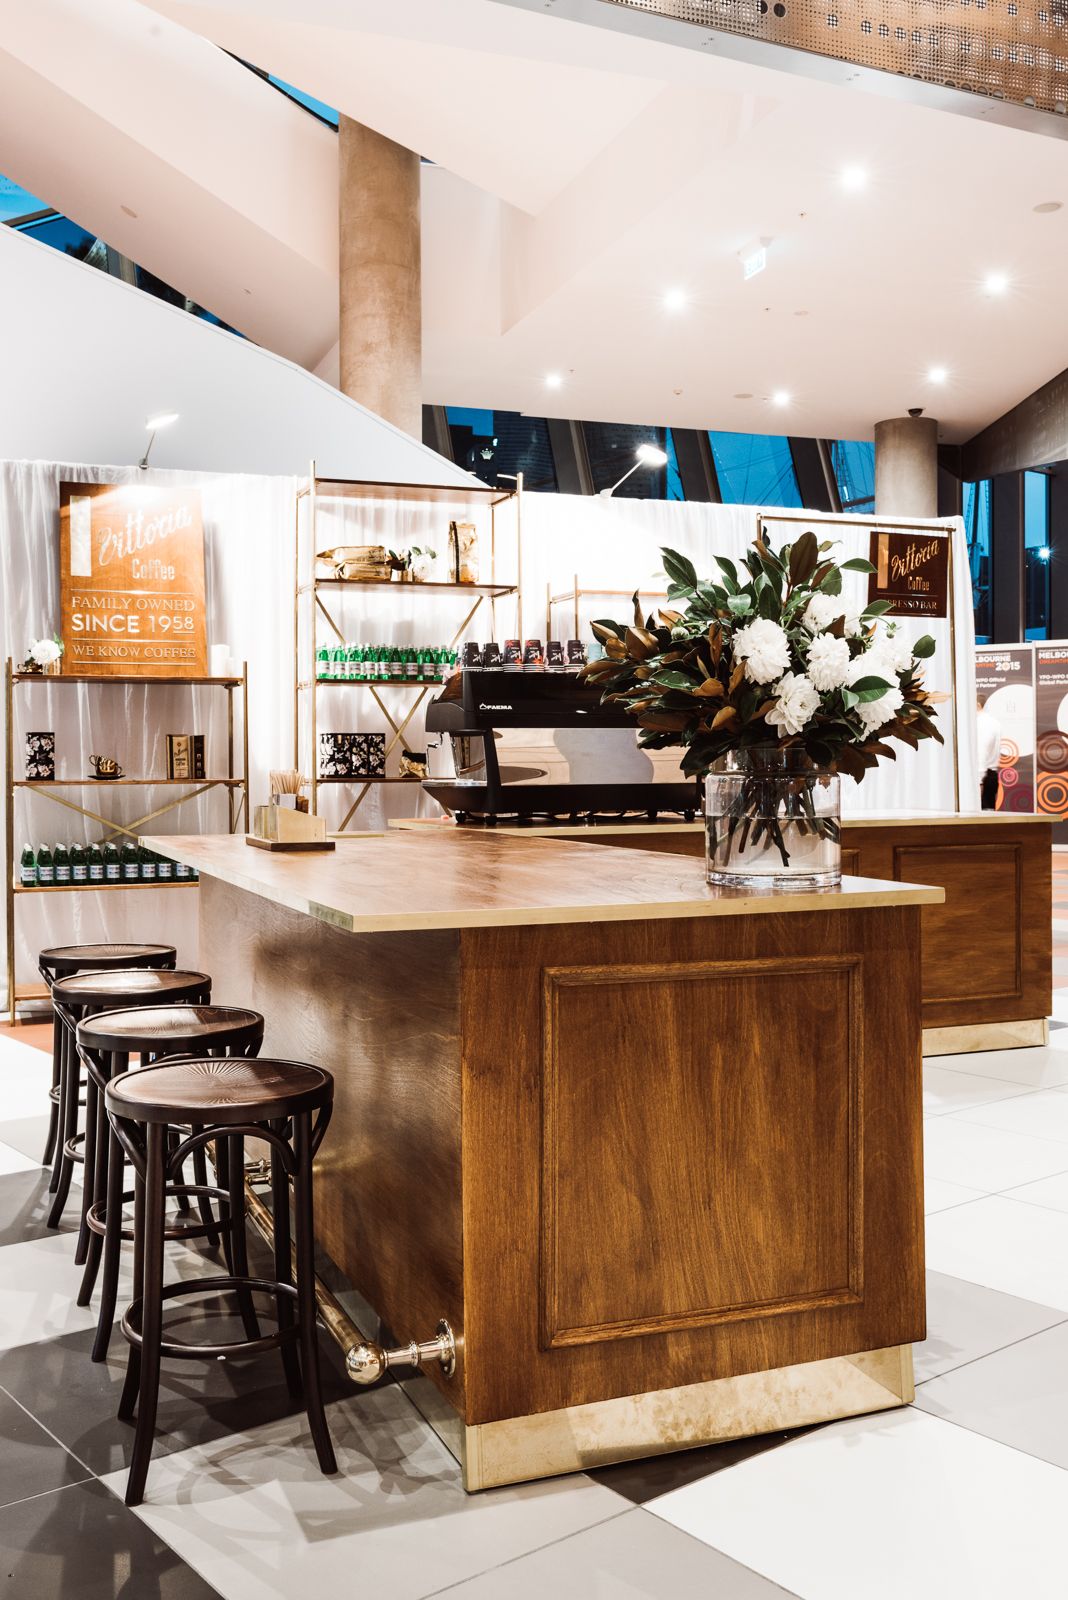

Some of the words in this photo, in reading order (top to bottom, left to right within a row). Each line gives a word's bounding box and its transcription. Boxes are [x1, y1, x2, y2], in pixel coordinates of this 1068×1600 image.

[96, 504, 193, 567] Vittoria
[891, 539, 940, 582] Vittoria
[131, 558, 176, 580] Coffee
[907, 576, 930, 591] Coffee
[71, 596, 135, 610] FAMILY
[136, 598, 195, 612] OWNED
[920, 600, 937, 610] BAR
[71, 613, 140, 633] SINCE
[149, 615, 195, 634] 1958
[72, 645, 95, 656] WE
[99, 645, 142, 658] KNOW
[144, 647, 196, 658] COFFEE
[976, 655, 1011, 663] LBOURNE
[995, 661, 1021, 672] 2015
